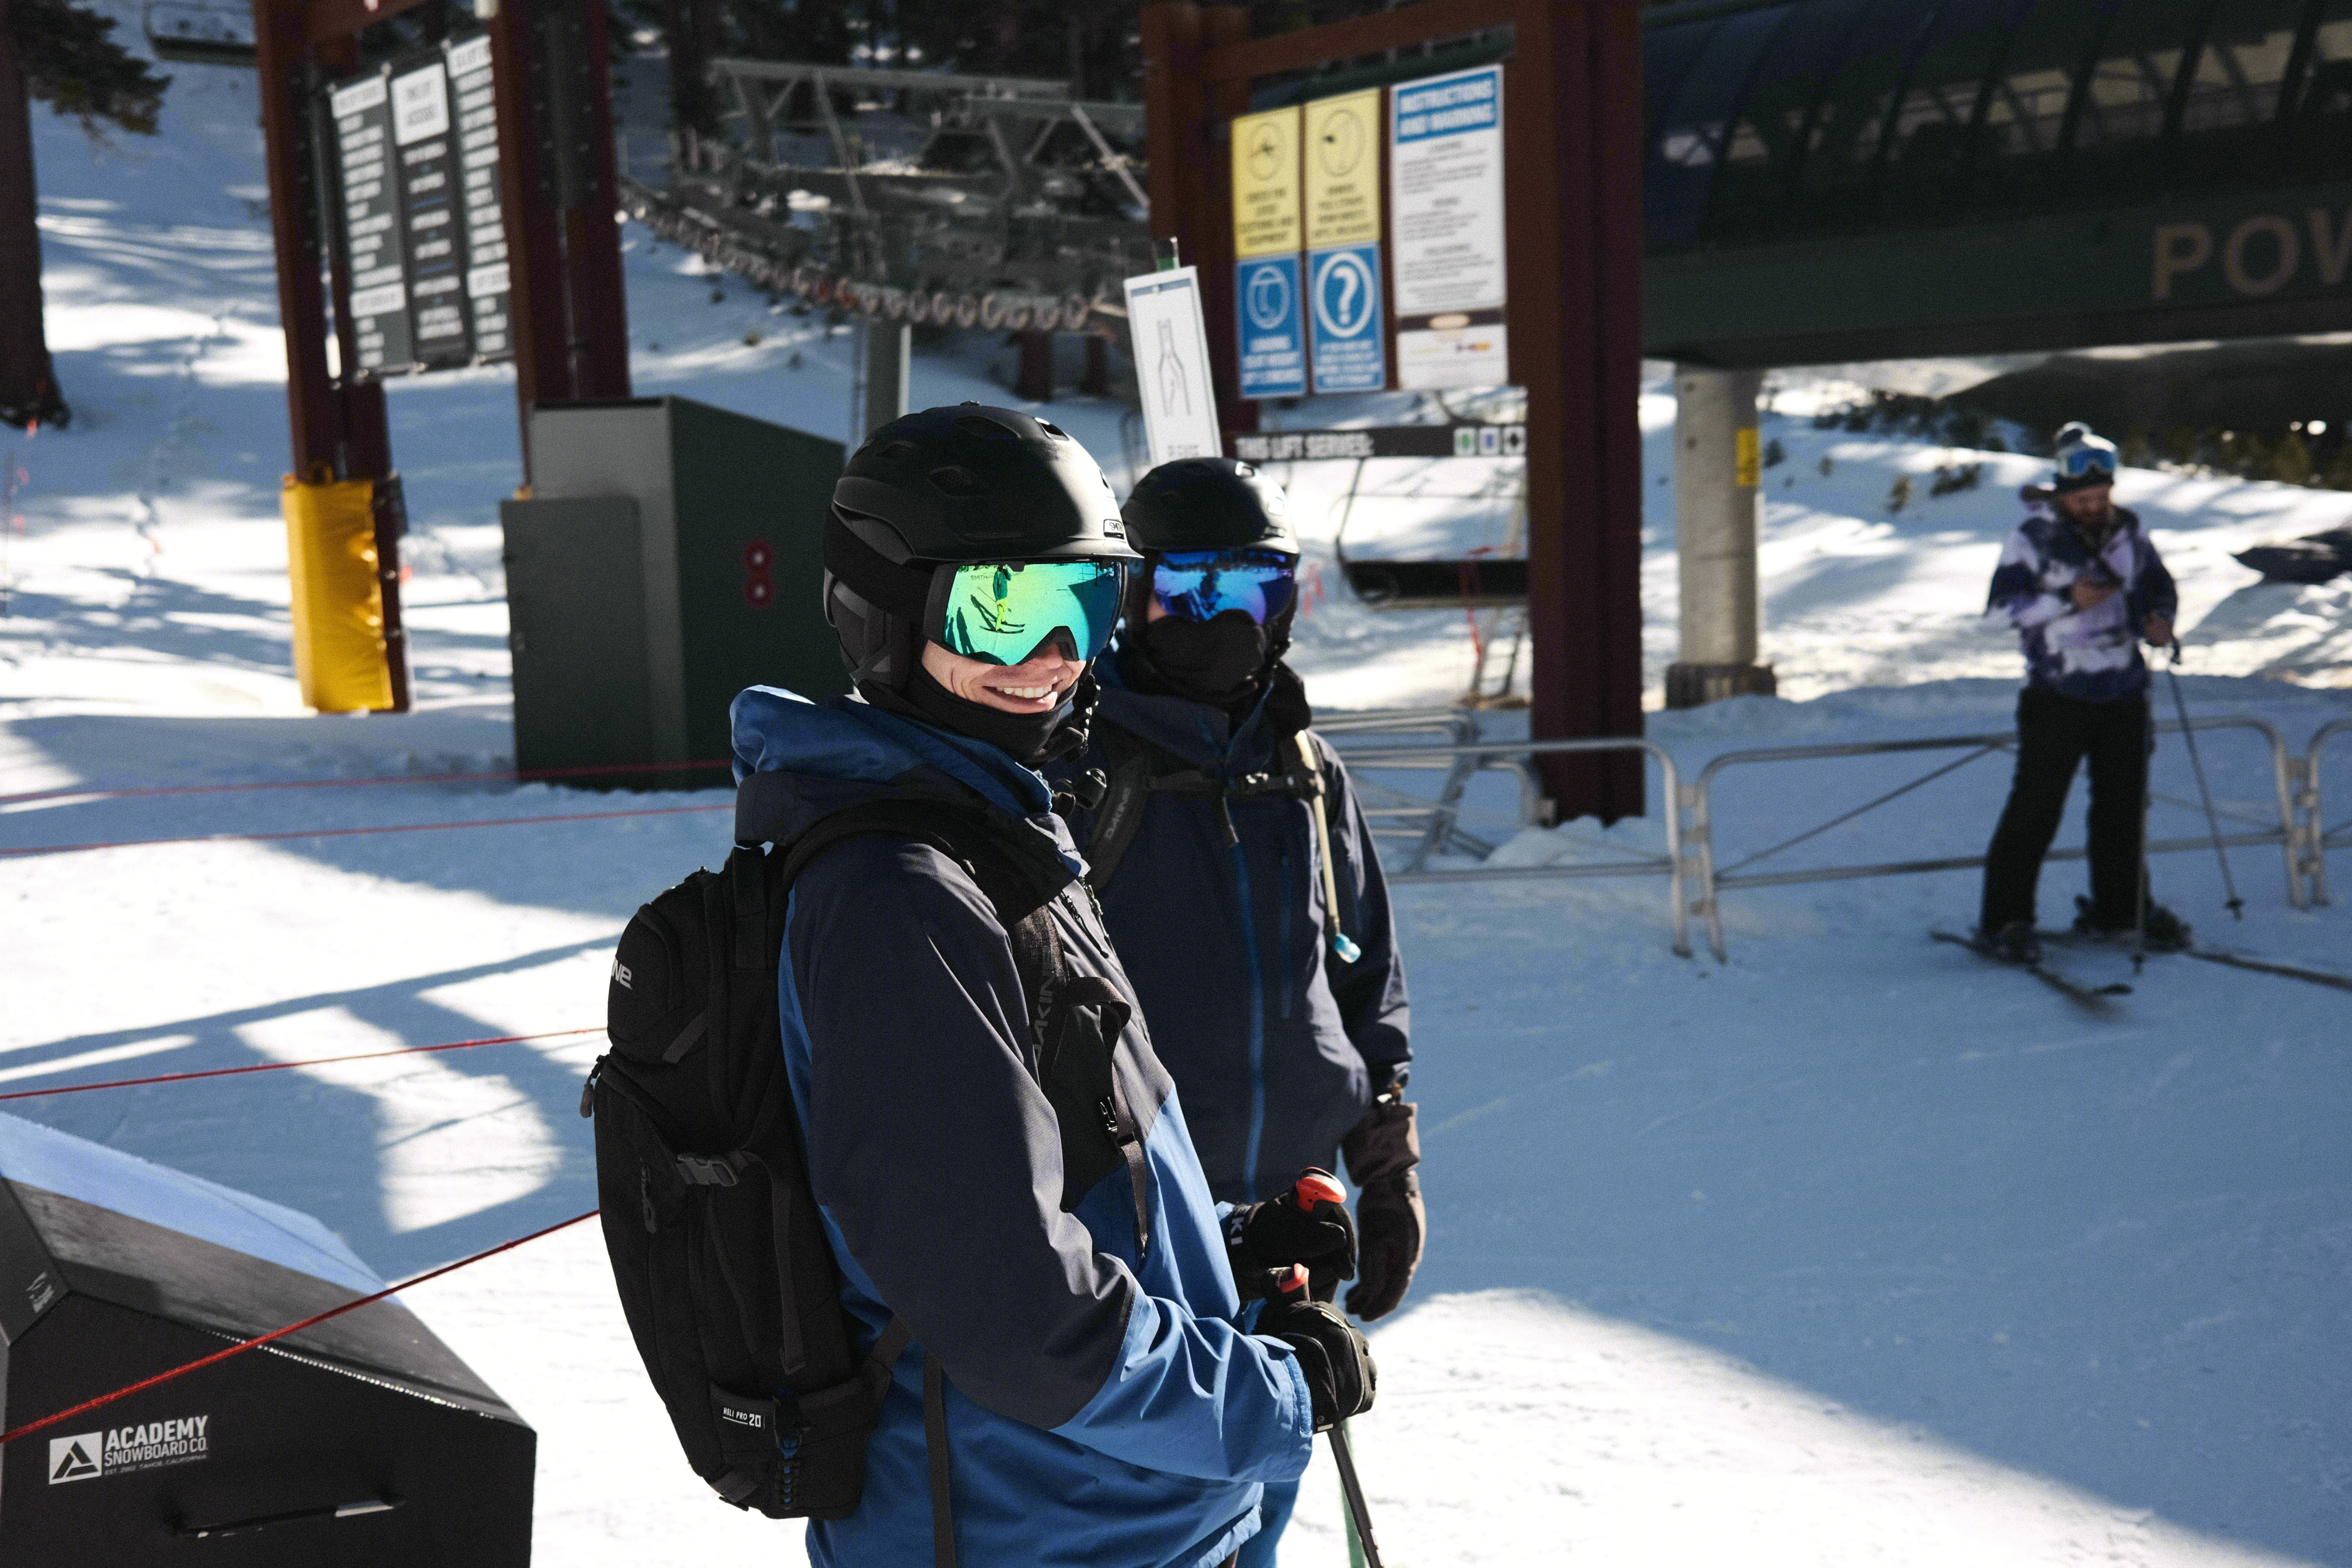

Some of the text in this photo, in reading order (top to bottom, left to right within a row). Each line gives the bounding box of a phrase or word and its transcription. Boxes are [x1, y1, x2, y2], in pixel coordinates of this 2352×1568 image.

[1109, 522, 1123, 532] SMITH
[723, 1407, 761, 1428] HELI PRO 20
[105, 1415, 208, 1451] ACADEMY
[104, 1440, 187, 1467] SNOWBOARD
